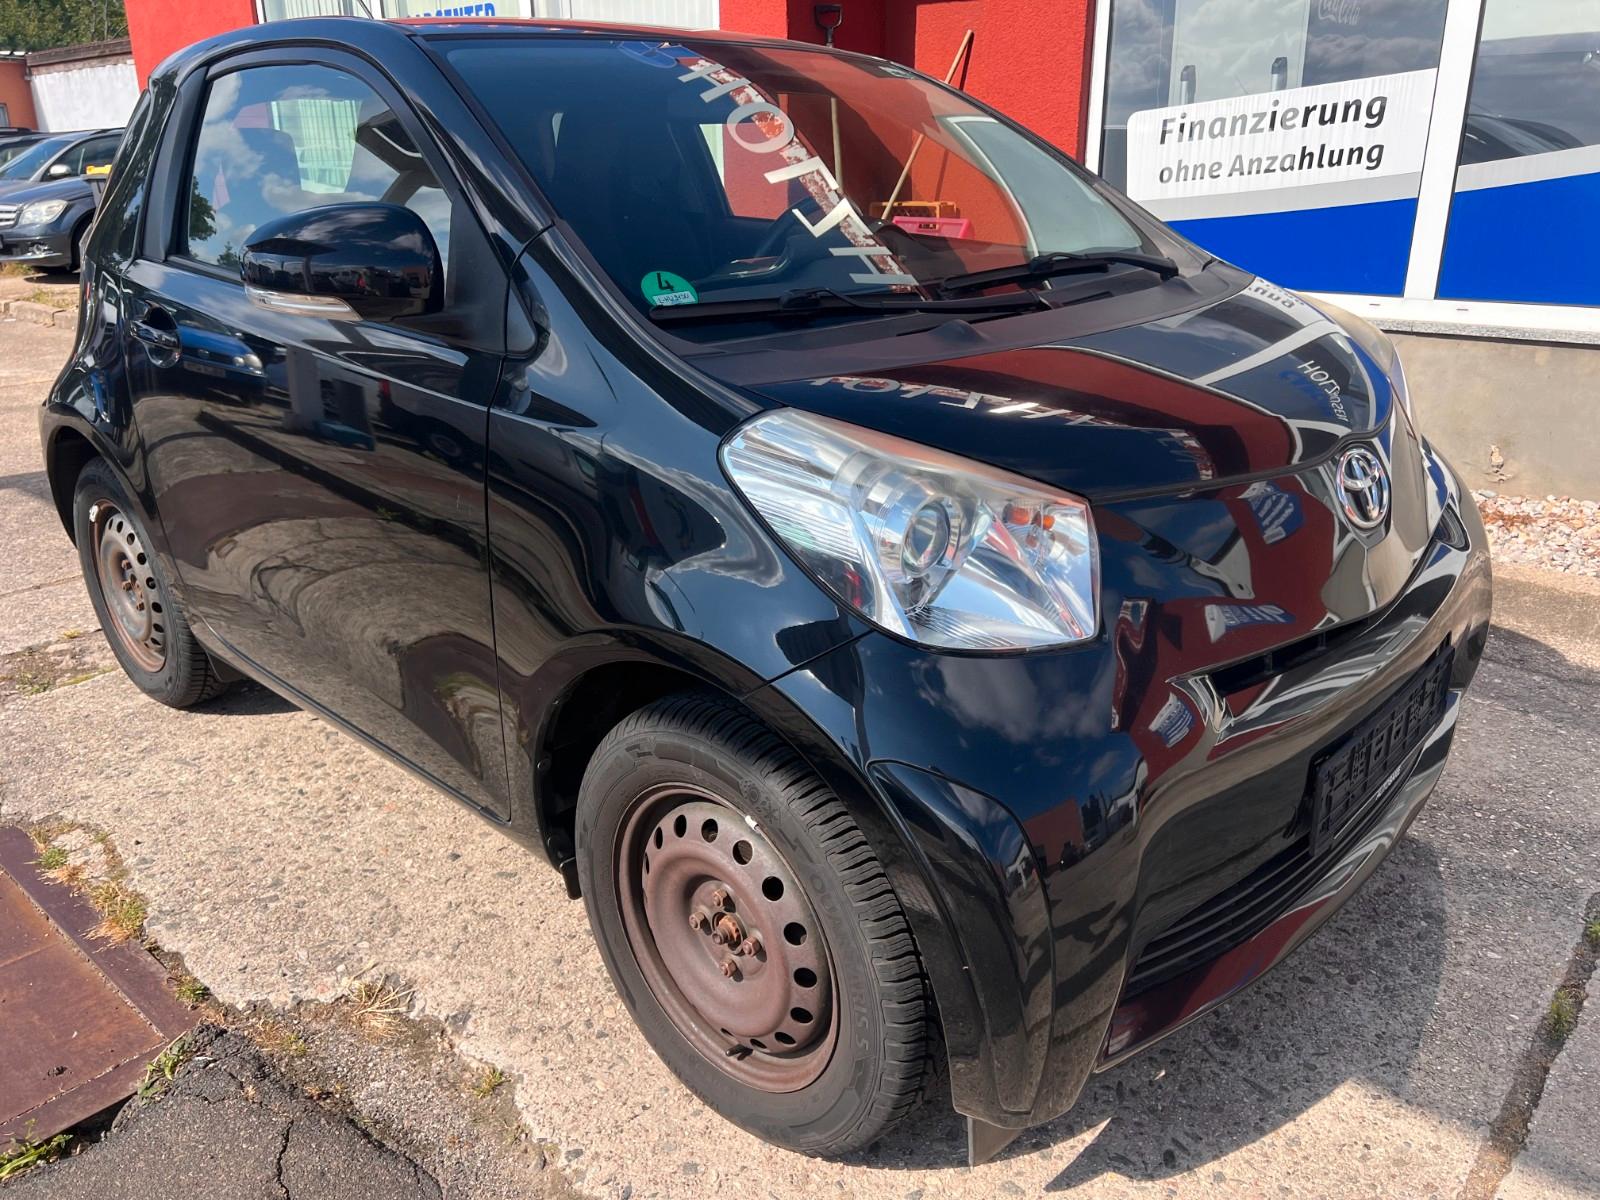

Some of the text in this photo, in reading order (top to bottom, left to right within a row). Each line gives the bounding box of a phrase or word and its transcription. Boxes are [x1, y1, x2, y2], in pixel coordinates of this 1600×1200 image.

[1159, 96, 1388, 145] Finanzierung
[1159, 143, 1385, 184] ohne Anzahlung
[657, 272, 674, 291] 4
